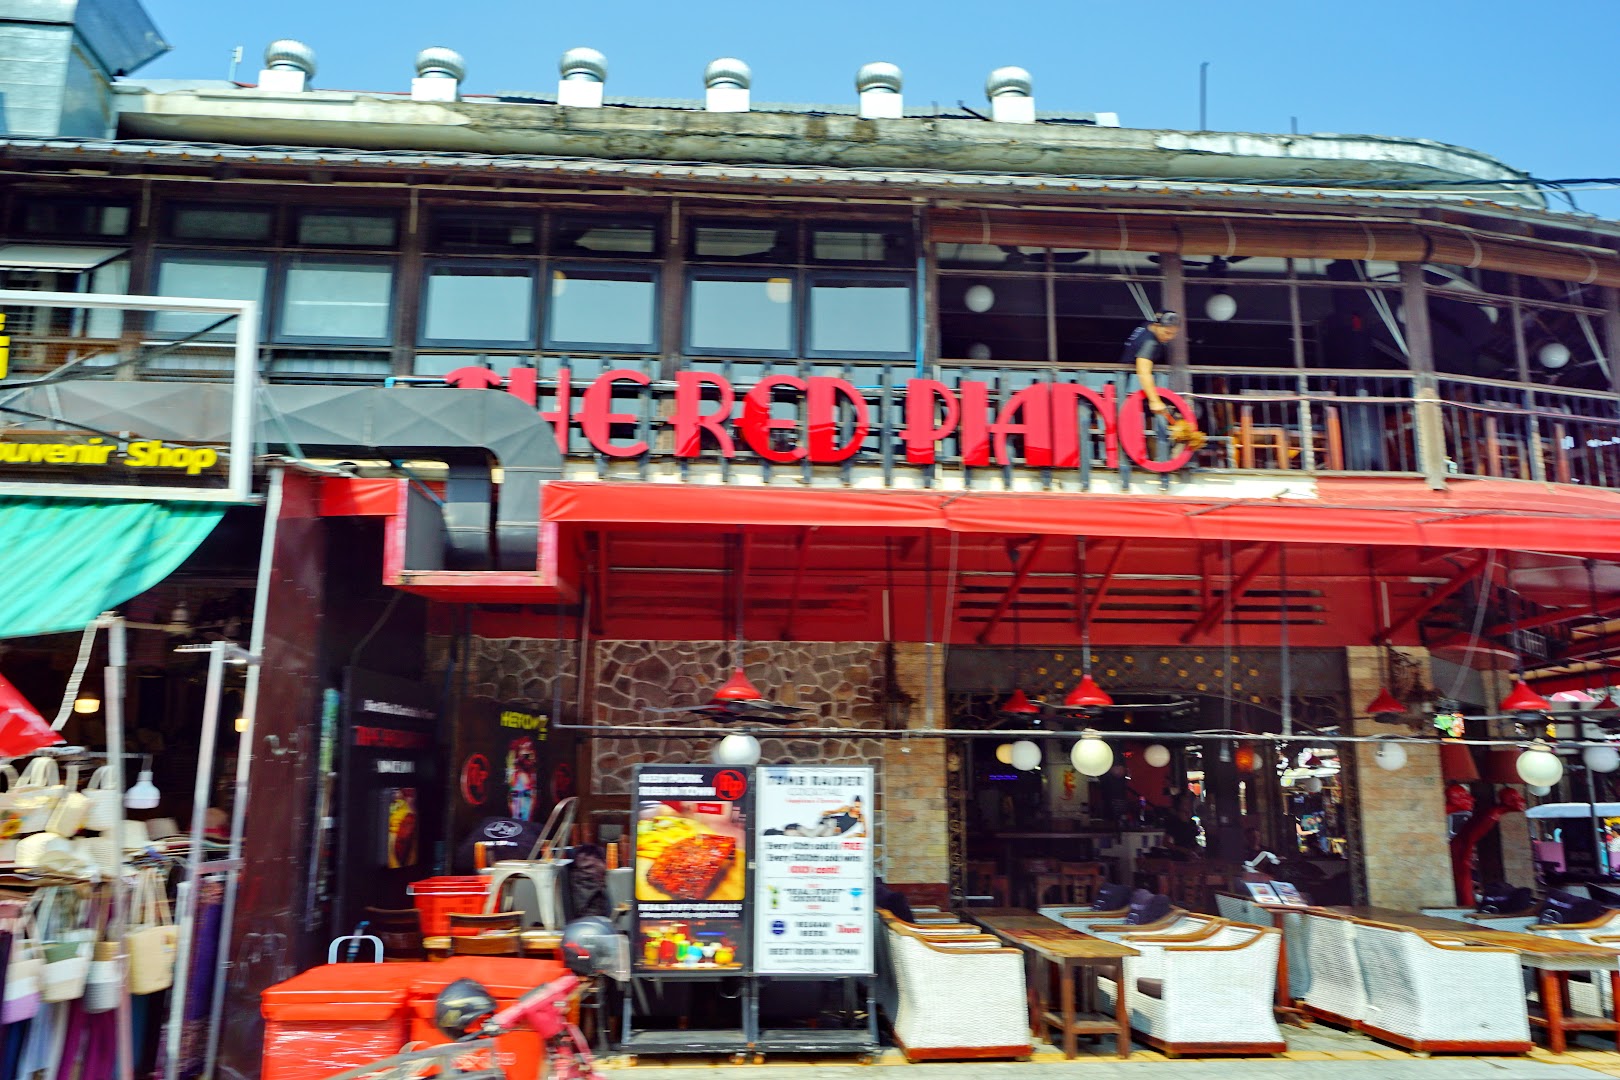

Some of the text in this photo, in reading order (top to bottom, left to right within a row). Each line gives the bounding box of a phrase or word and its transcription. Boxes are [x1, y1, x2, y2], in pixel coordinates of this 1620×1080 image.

[445, 366, 1197, 473] HE RED PIANO
[124, 440, 218, 474] Shop
